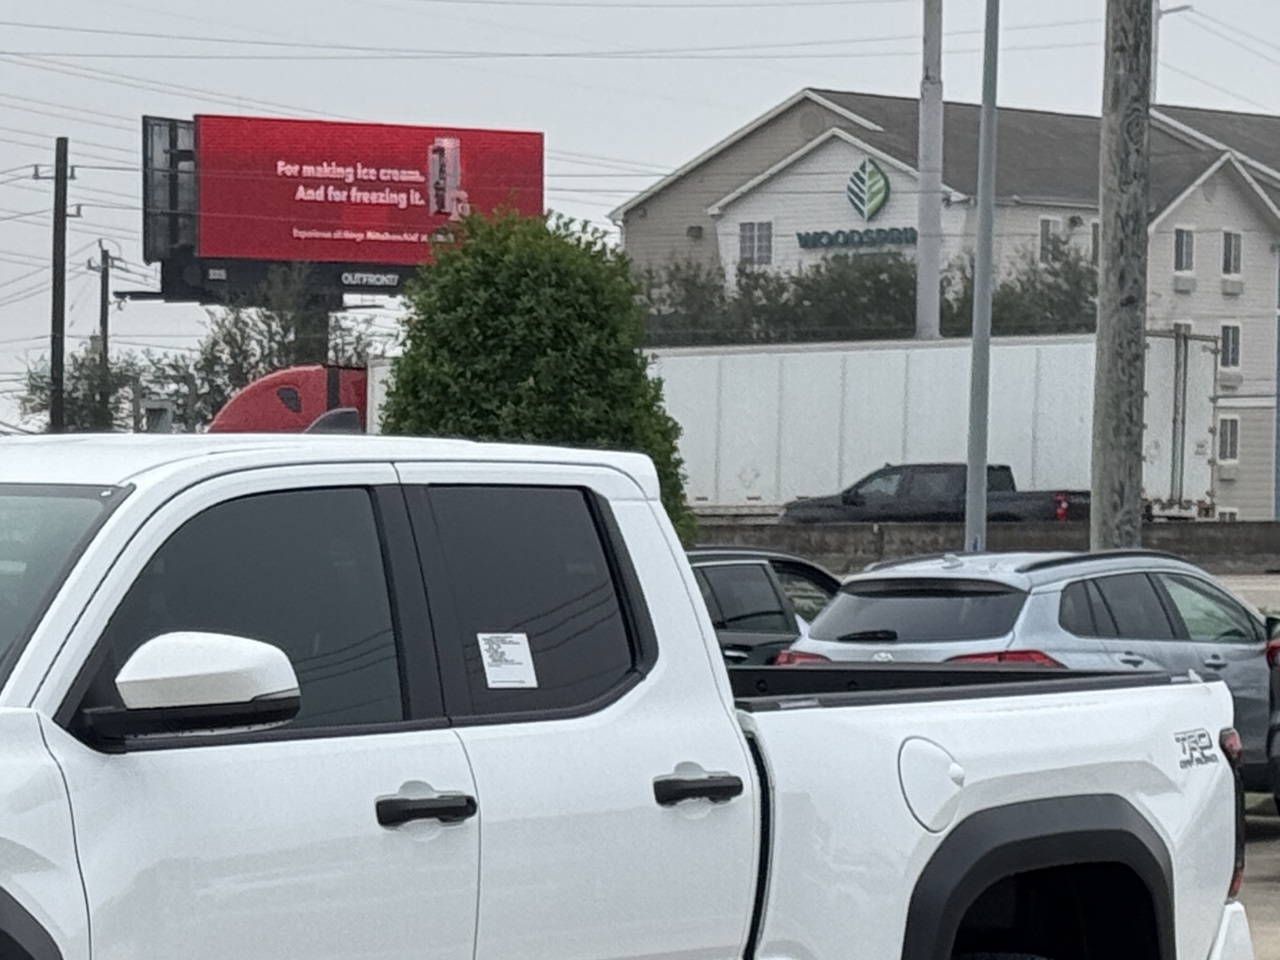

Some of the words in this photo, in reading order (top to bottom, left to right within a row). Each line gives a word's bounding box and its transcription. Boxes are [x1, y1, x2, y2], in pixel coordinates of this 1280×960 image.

[276, 160, 300, 177] For
[302, 161, 355, 183] making
[357, 162, 378, 181] ice
[379, 167, 426, 182] cream.
[295, 185, 325, 202] And
[327, 185, 348, 202] for
[350, 186, 408, 209] freezing
[796, 226, 918, 249] WOODSPRIN
